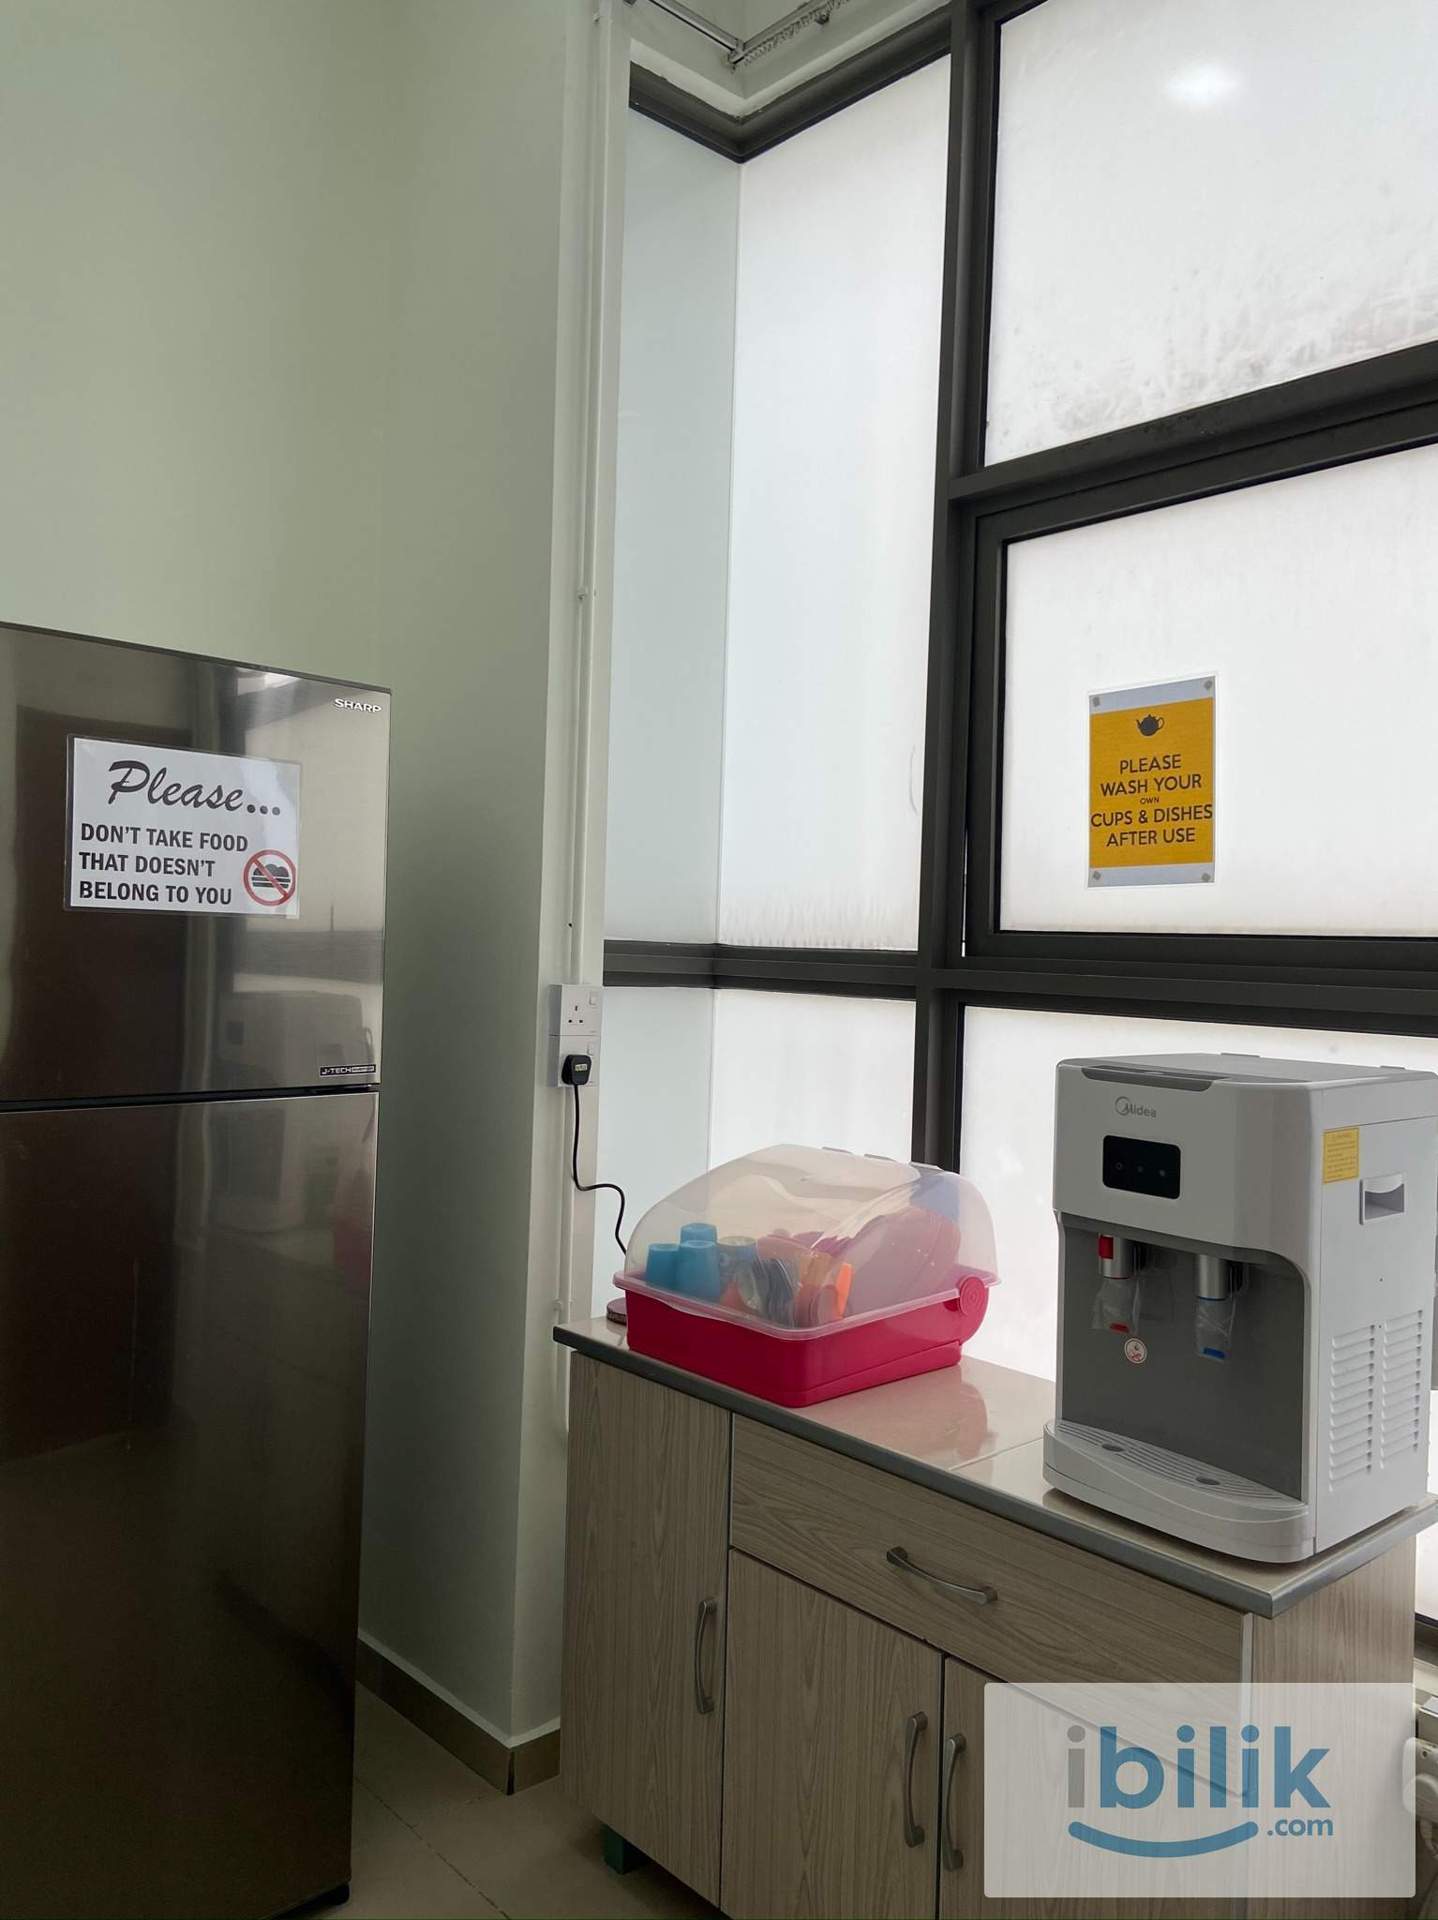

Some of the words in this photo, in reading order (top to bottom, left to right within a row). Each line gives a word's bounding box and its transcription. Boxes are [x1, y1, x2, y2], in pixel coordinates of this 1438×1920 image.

[335, 698, 382, 713] SHARP
[1120, 754, 1181, 774] PLEASE
[1100, 779, 1148, 796] WASH
[1153, 773, 1201, 791] YOUR
[1091, 810, 1132, 827] CUPS
[1138, 811, 1148, 823] &
[1153, 804, 1213, 823] DISHES
[81, 823, 141, 844] DON'T
[146, 828, 193, 848] TAKE
[200, 832, 248, 851] FOOD
[1106, 830, 1157, 847] AFTER
[1163, 827, 1196, 843] USE
[79, 852, 128, 871] THAT
[135, 856, 215, 877] DOESN'T
[80, 881, 159, 901] BELONG
[166, 885, 189, 903] TO
[196, 887, 232, 904] YOU
[1115, 1096, 1157, 1118] Midea
